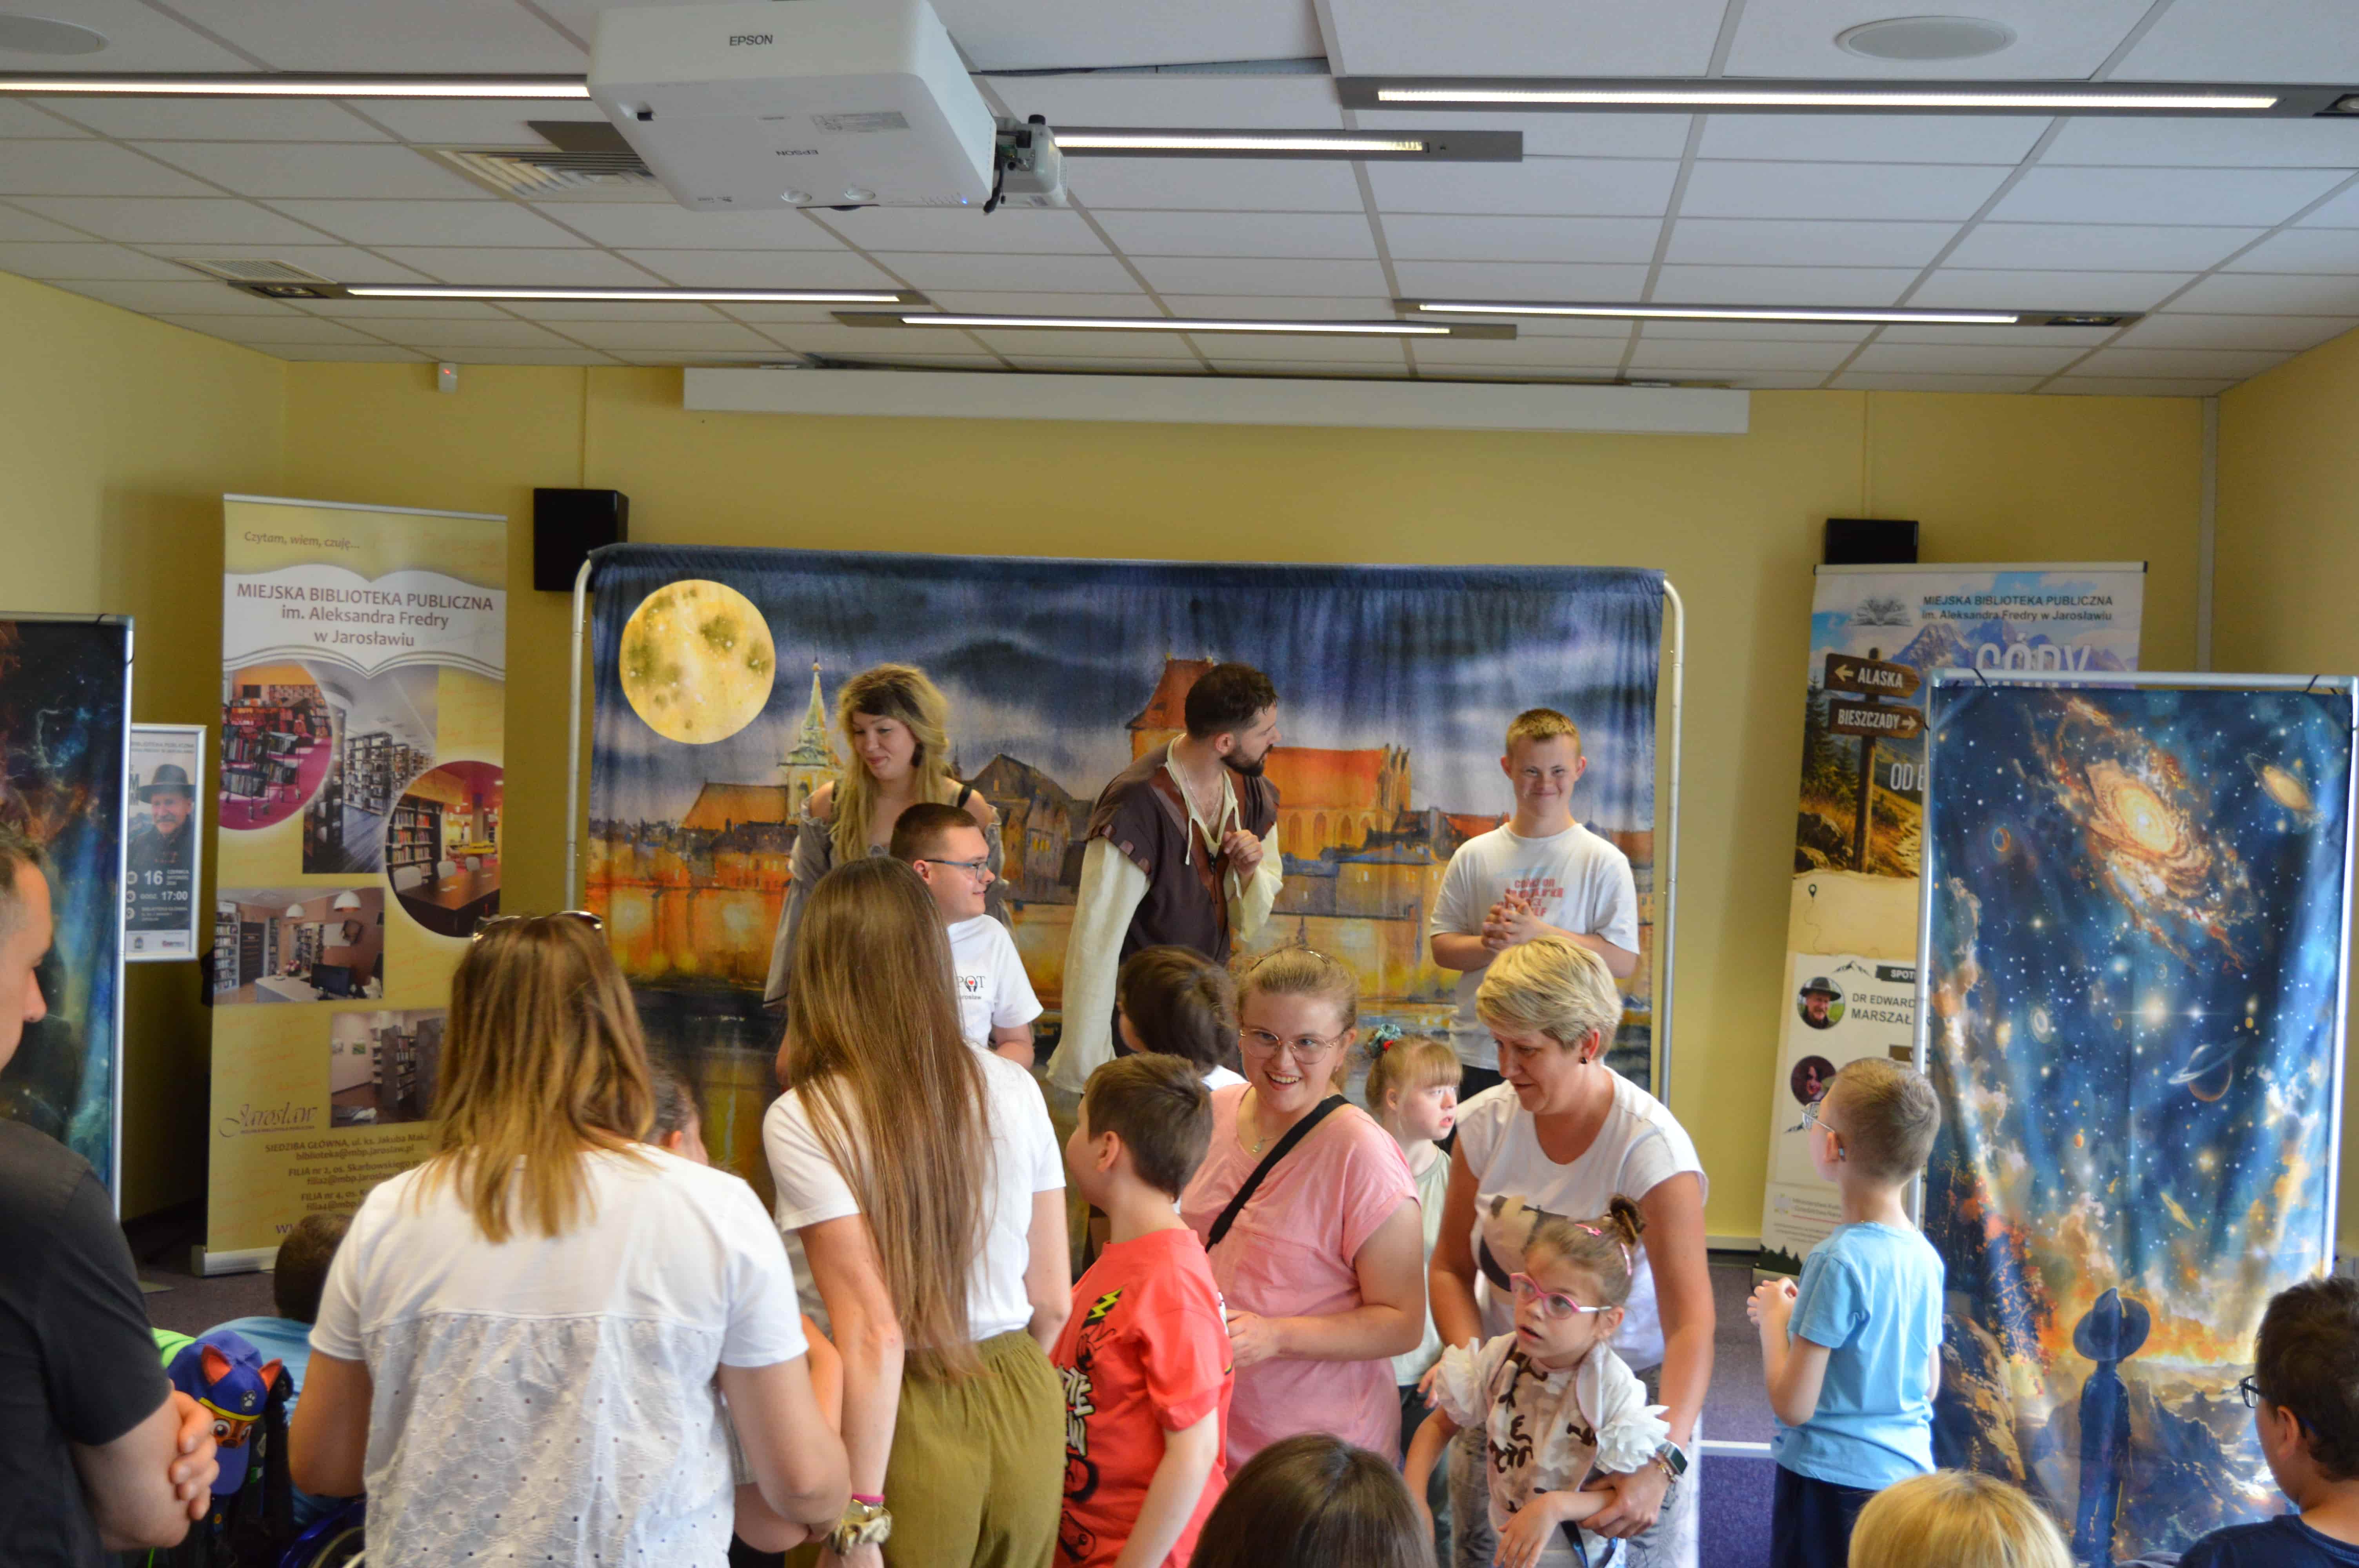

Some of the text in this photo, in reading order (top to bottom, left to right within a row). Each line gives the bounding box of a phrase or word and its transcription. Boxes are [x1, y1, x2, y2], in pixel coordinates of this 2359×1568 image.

[730, 34, 773, 46] EPSON
[244, 531, 287, 545] Czytam,
[289, 534, 322, 548] wiem,
[237, 583, 493, 610] MIEJSKA BIBLIOTEKA PUBLICZNA
[1923, 595, 2113, 606] MIEJSKA BIBLIOTEKA PUBLICZNA
[282, 605, 449, 630] im. Aleksandra Fredry
[1922, 610, 1936, 619] im.
[1940, 610, 1999, 620] Aleksandra
[2002, 610, 2037, 622] Fredry
[2052, 610, 2113, 621] Jarosławiu
[314, 630, 414, 646] w Jarosławiu
[1857, 667, 1903, 689] ALASKA
[1837, 708, 1901, 729] BIESZCZADY
[1890, 763, 1913, 790] OD
[145, 870, 163, 886] 16
[161, 891, 188, 900] 17:00
[1852, 993, 1915, 1008] DR EDWARD
[1851, 1007, 1932, 1027] MARSZAŁ
[265, 1142, 305, 1153] SIEDZIBA
[288, 1167, 310, 1176] FILIA
[301, 1192, 322, 1201] FILIA
